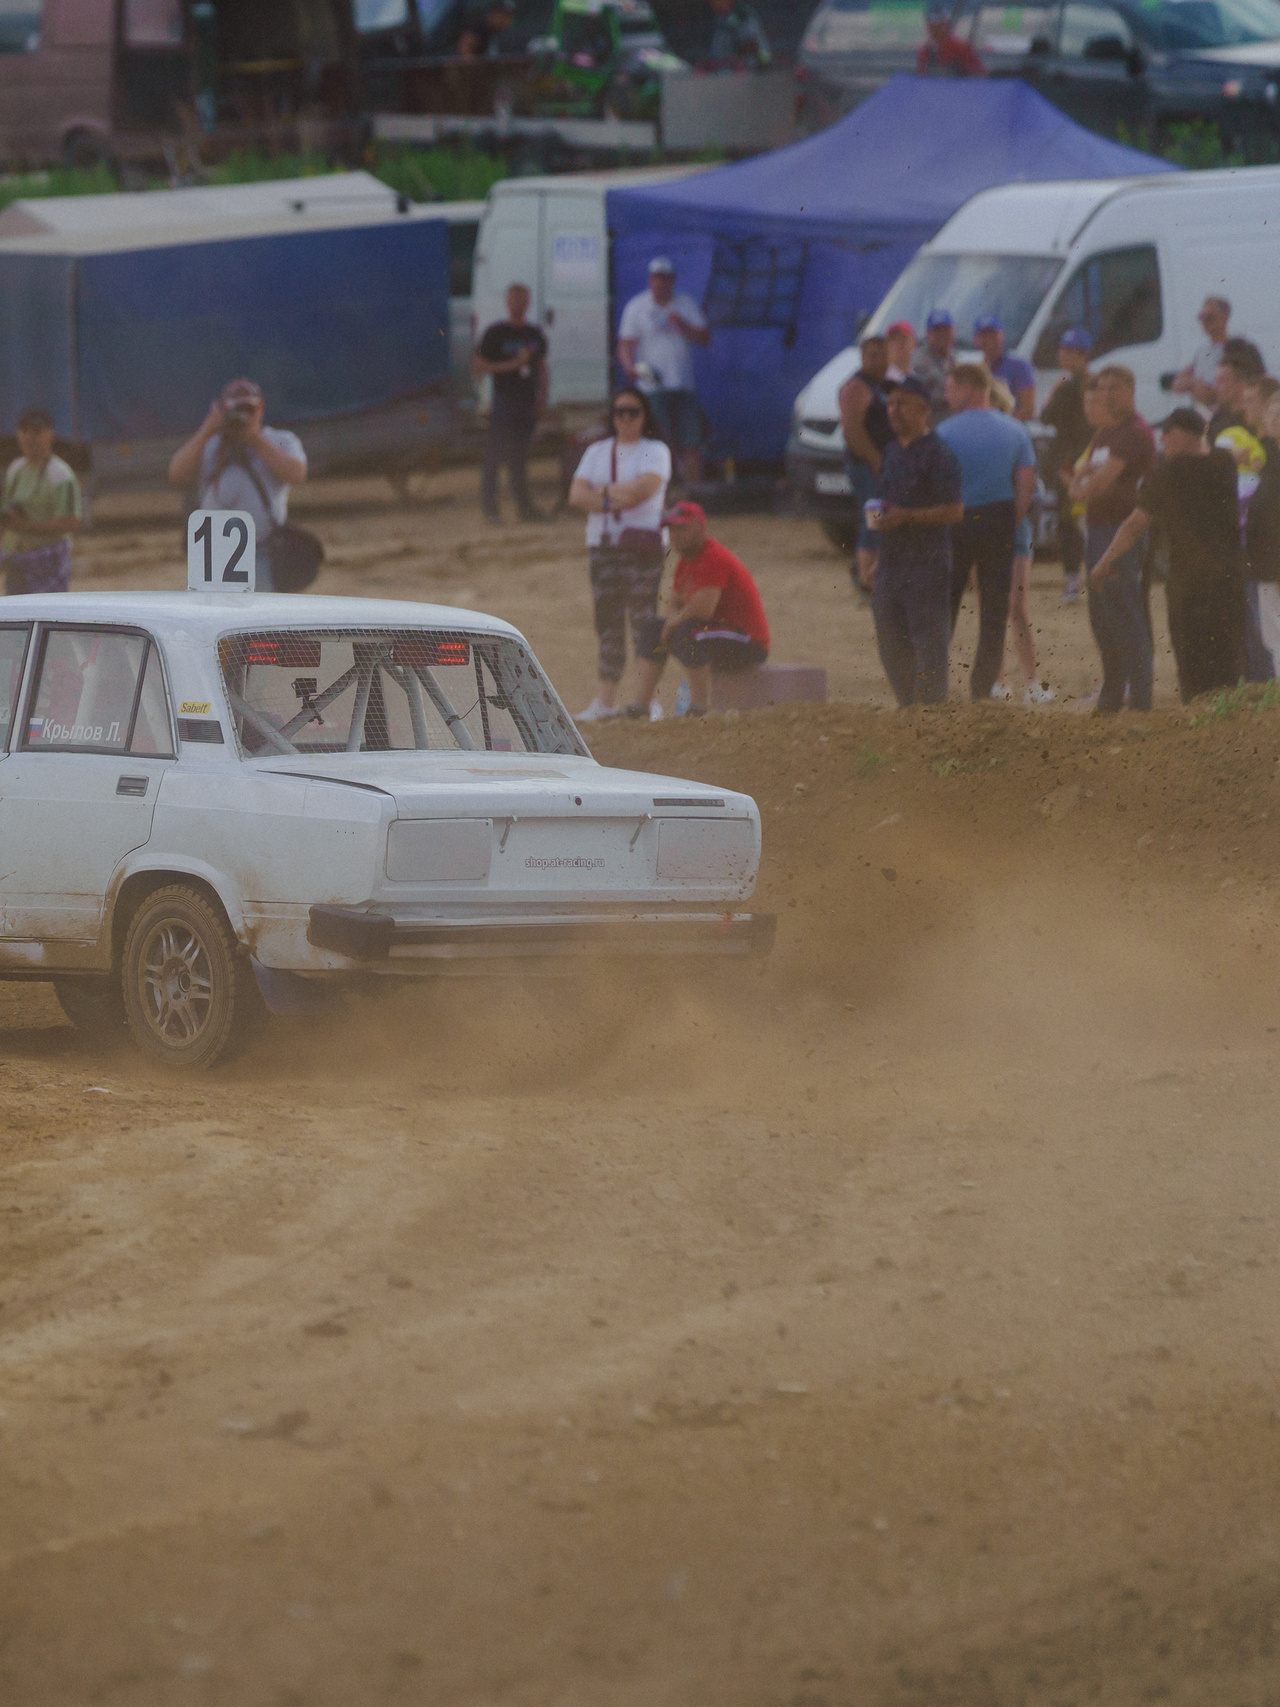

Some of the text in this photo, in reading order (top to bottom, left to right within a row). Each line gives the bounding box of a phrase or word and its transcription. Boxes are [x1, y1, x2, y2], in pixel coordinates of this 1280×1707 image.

[194, 516, 249, 583] 12
[180, 702, 208, 713] Sabelt
[42, 719, 121, 743] Крылов Л.
[525, 856, 605, 870] shop.at-racing.ru
